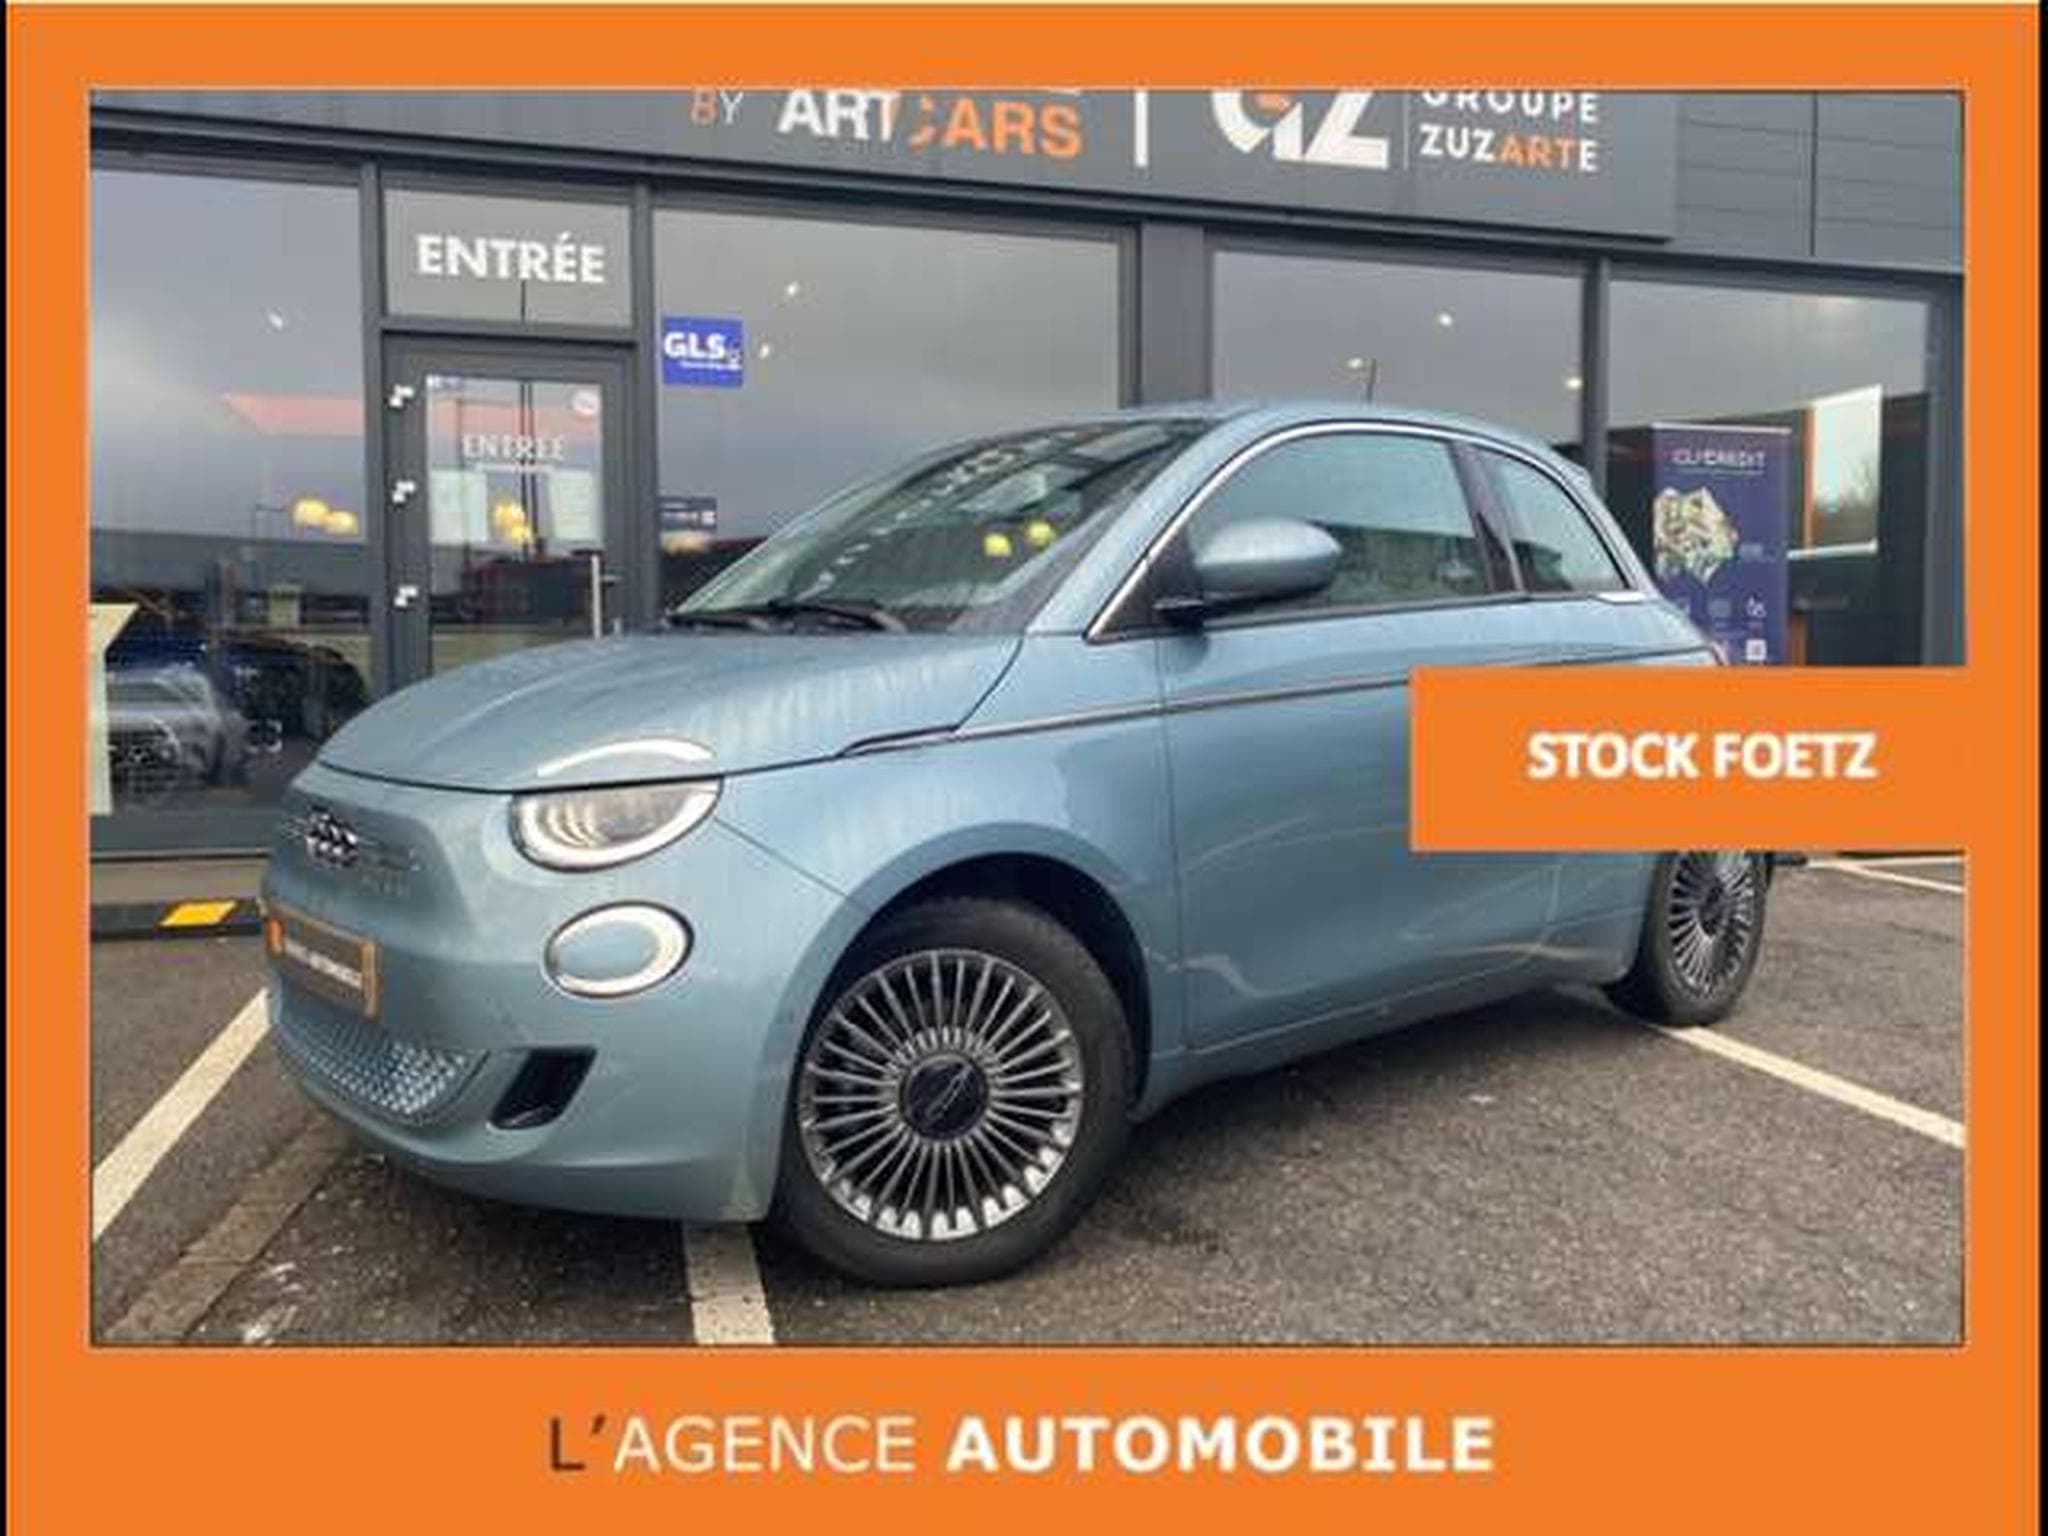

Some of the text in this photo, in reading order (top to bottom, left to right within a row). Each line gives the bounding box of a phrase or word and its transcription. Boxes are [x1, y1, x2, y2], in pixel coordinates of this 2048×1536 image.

[1419, 123, 1599, 172] ZUZARTE
[416, 231, 606, 284] ENTRÉE
[664, 331, 726, 359] GLS
